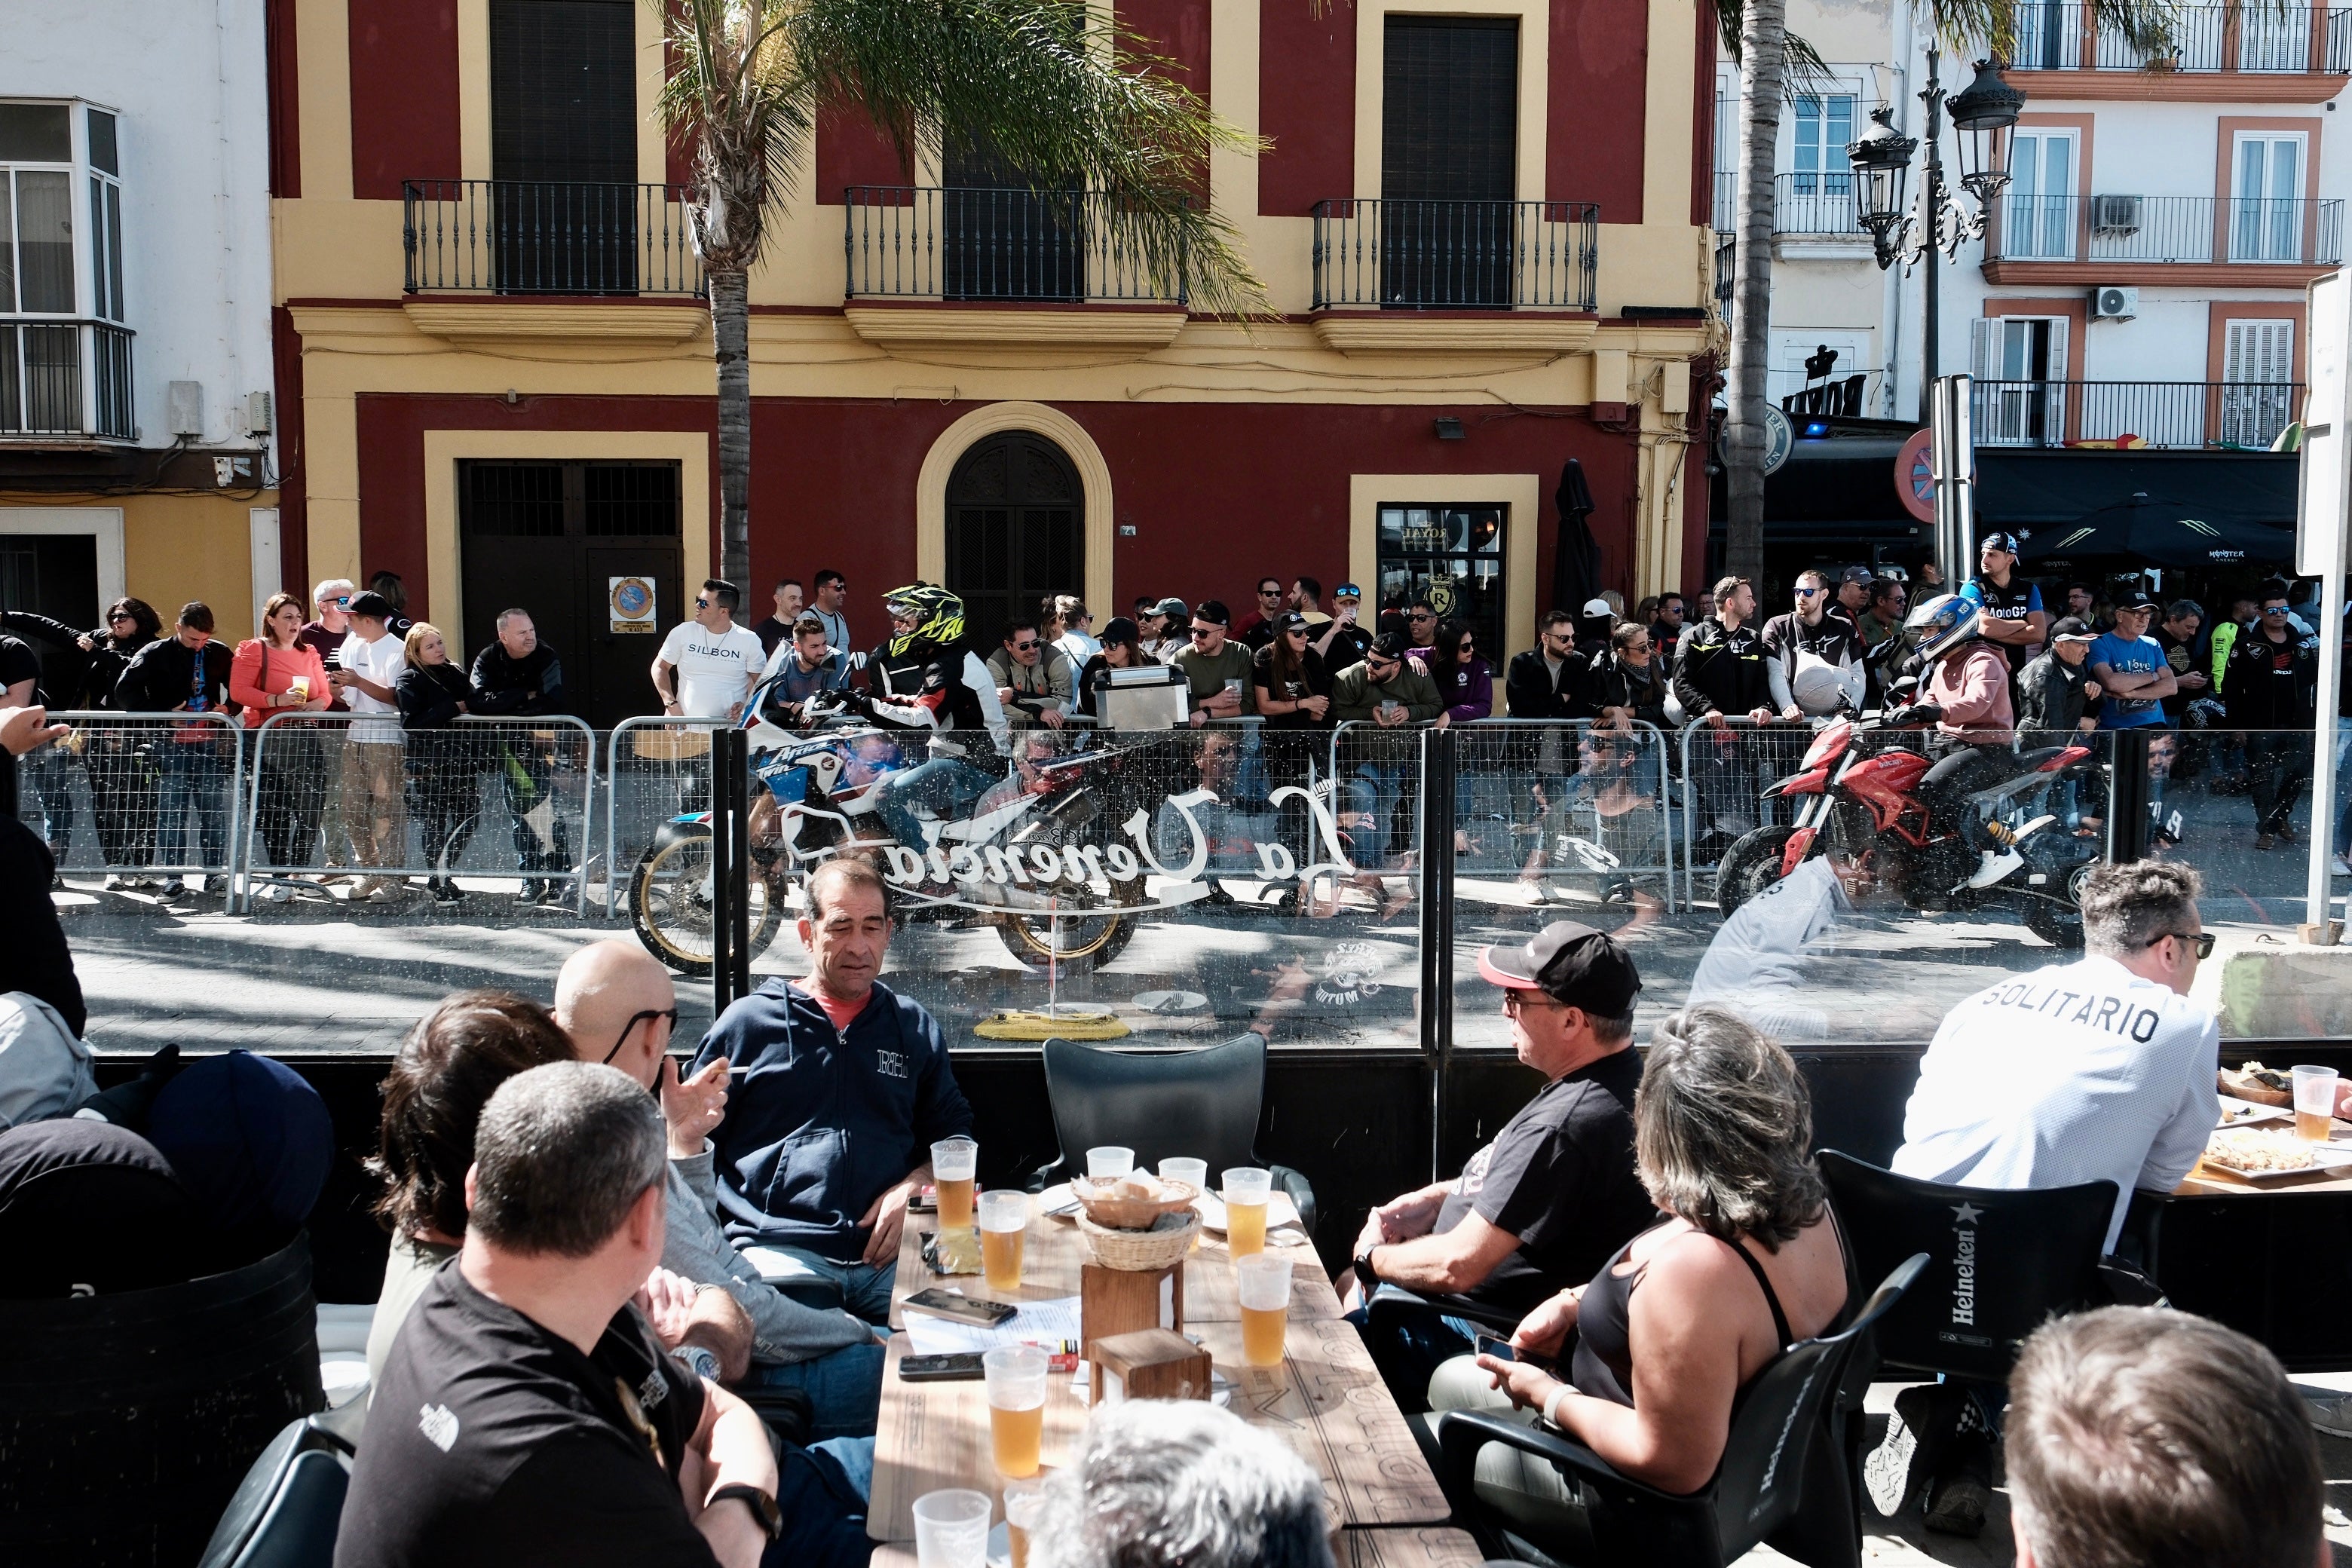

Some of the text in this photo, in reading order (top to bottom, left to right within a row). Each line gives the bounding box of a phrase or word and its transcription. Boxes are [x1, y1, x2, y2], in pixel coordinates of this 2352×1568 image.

[2209, 550, 2245, 559] MONSTER
[1434, 593, 1447, 605] R
[688, 644, 740, 659] SILBON
[769, 742, 828, 764] Africa
[1982, 983, 2160, 1044] SOLITARIO
[1952, 1224, 1975, 1326] Heineken
